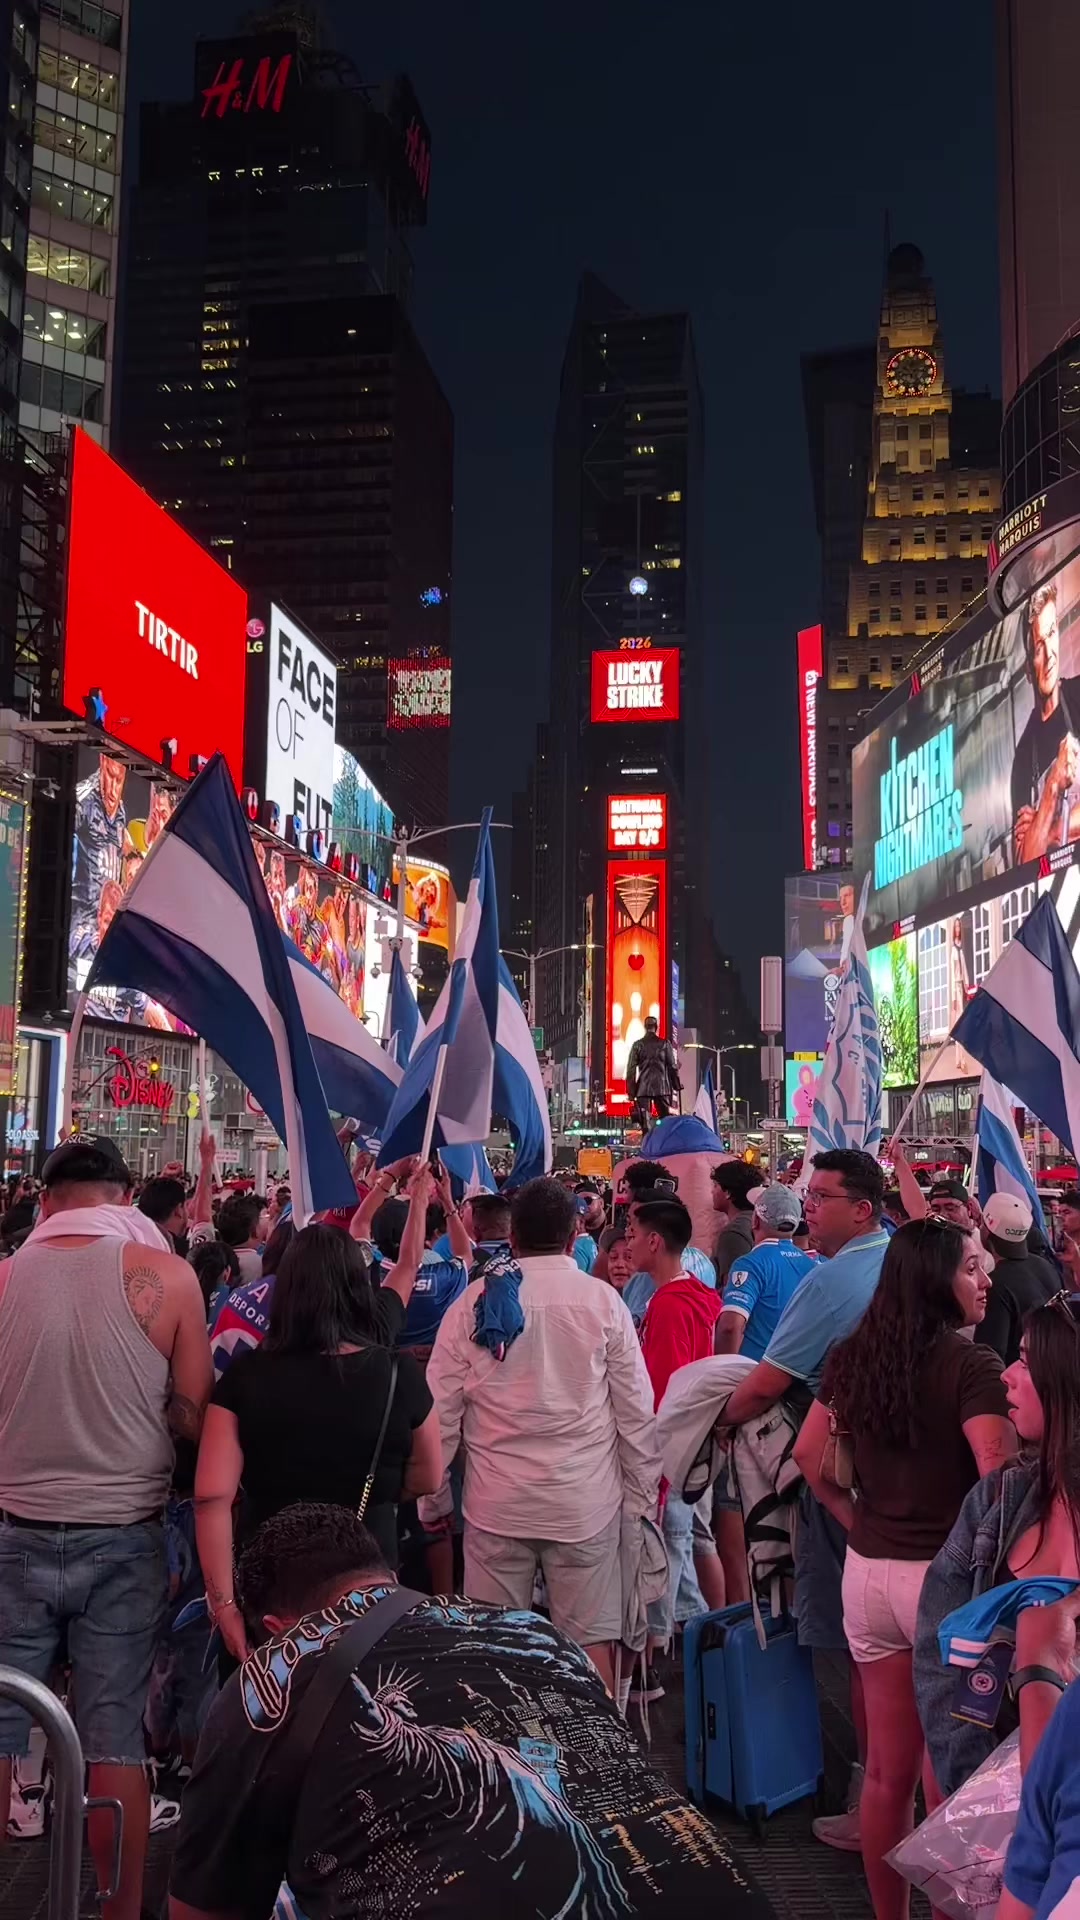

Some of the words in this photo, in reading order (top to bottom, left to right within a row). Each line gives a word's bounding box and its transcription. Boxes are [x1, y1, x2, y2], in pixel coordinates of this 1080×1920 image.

[200, 53, 293, 118] H&M
[998, 494, 1048, 540] MARRIOTT
[998, 514, 1042, 557] MARQUIS
[134, 600, 199, 679] TIRTIR
[246, 641, 264, 653] LG
[619, 637, 652, 650] 2026
[920, 647, 945, 674] MARRIOTT
[278, 628, 334, 728] FACE
[606, 685, 664, 709] STRIKE
[608, 660, 663, 685] LUCKY
[276, 697, 306, 759] OF
[880, 723, 955, 838] KITCHEN
[293, 776, 333, 848] FUT
[262, 799, 393, 904] BROADWA
[874, 789, 963, 891] NIGHTMARES
[228, 1293, 271, 1331] DEPOR
